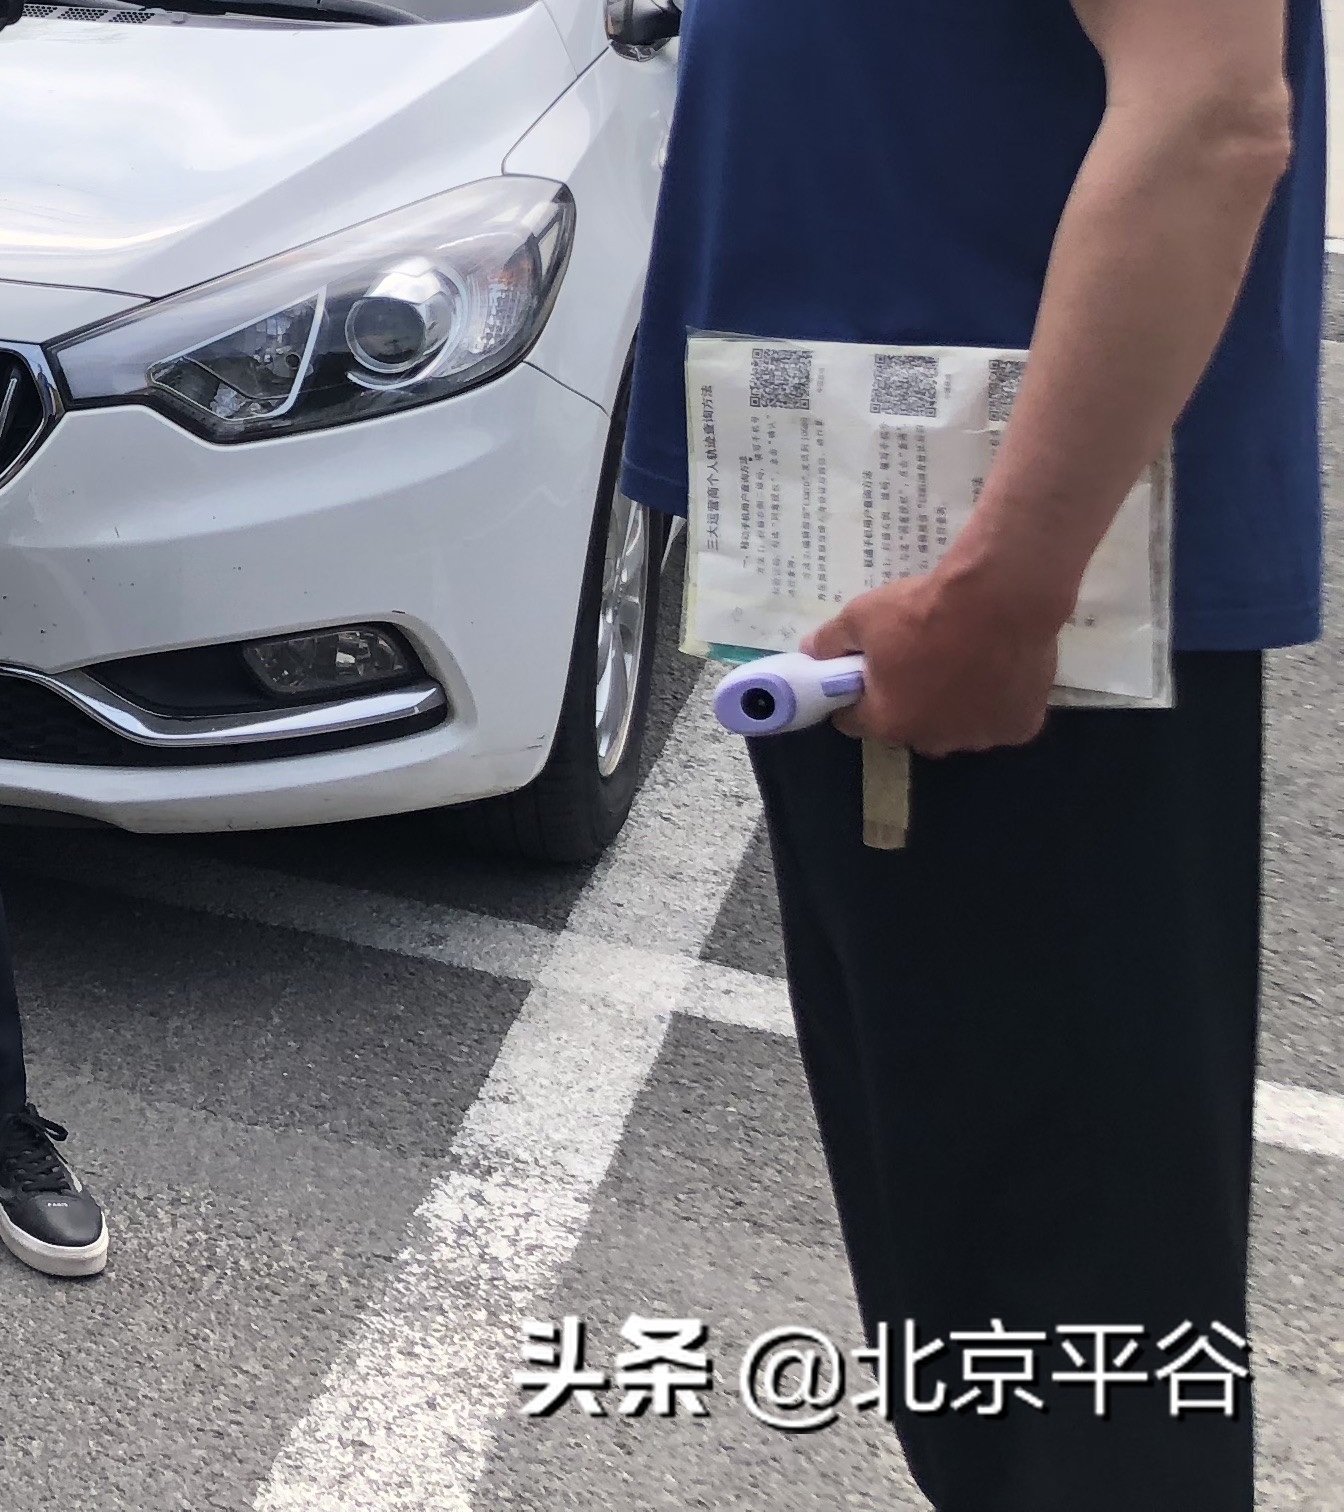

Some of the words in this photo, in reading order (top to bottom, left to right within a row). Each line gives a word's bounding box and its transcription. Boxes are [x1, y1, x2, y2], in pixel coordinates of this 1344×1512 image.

[701, 385, 719, 551] 三大运营商个人轨迹查询方法
